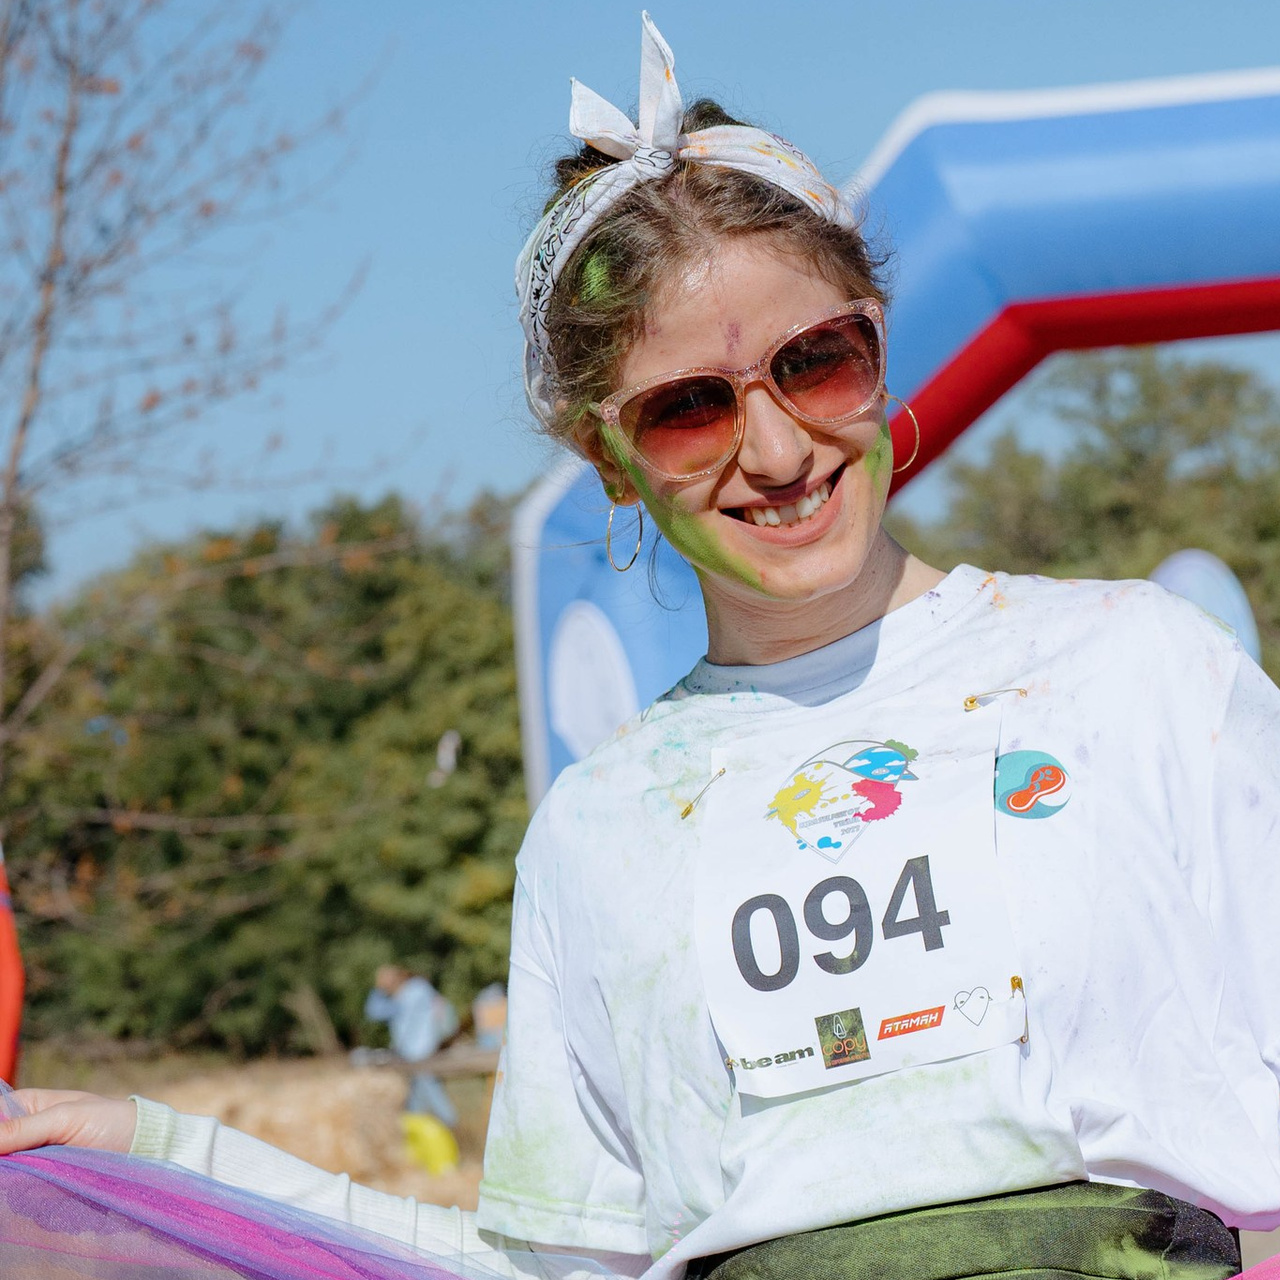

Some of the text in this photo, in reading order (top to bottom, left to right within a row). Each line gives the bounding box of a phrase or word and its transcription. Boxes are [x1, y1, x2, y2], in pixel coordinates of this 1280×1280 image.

[730, 854, 952, 993] 094
[822, 1034, 867, 1056] copy
[740, 1046, 815, 1070] beam
